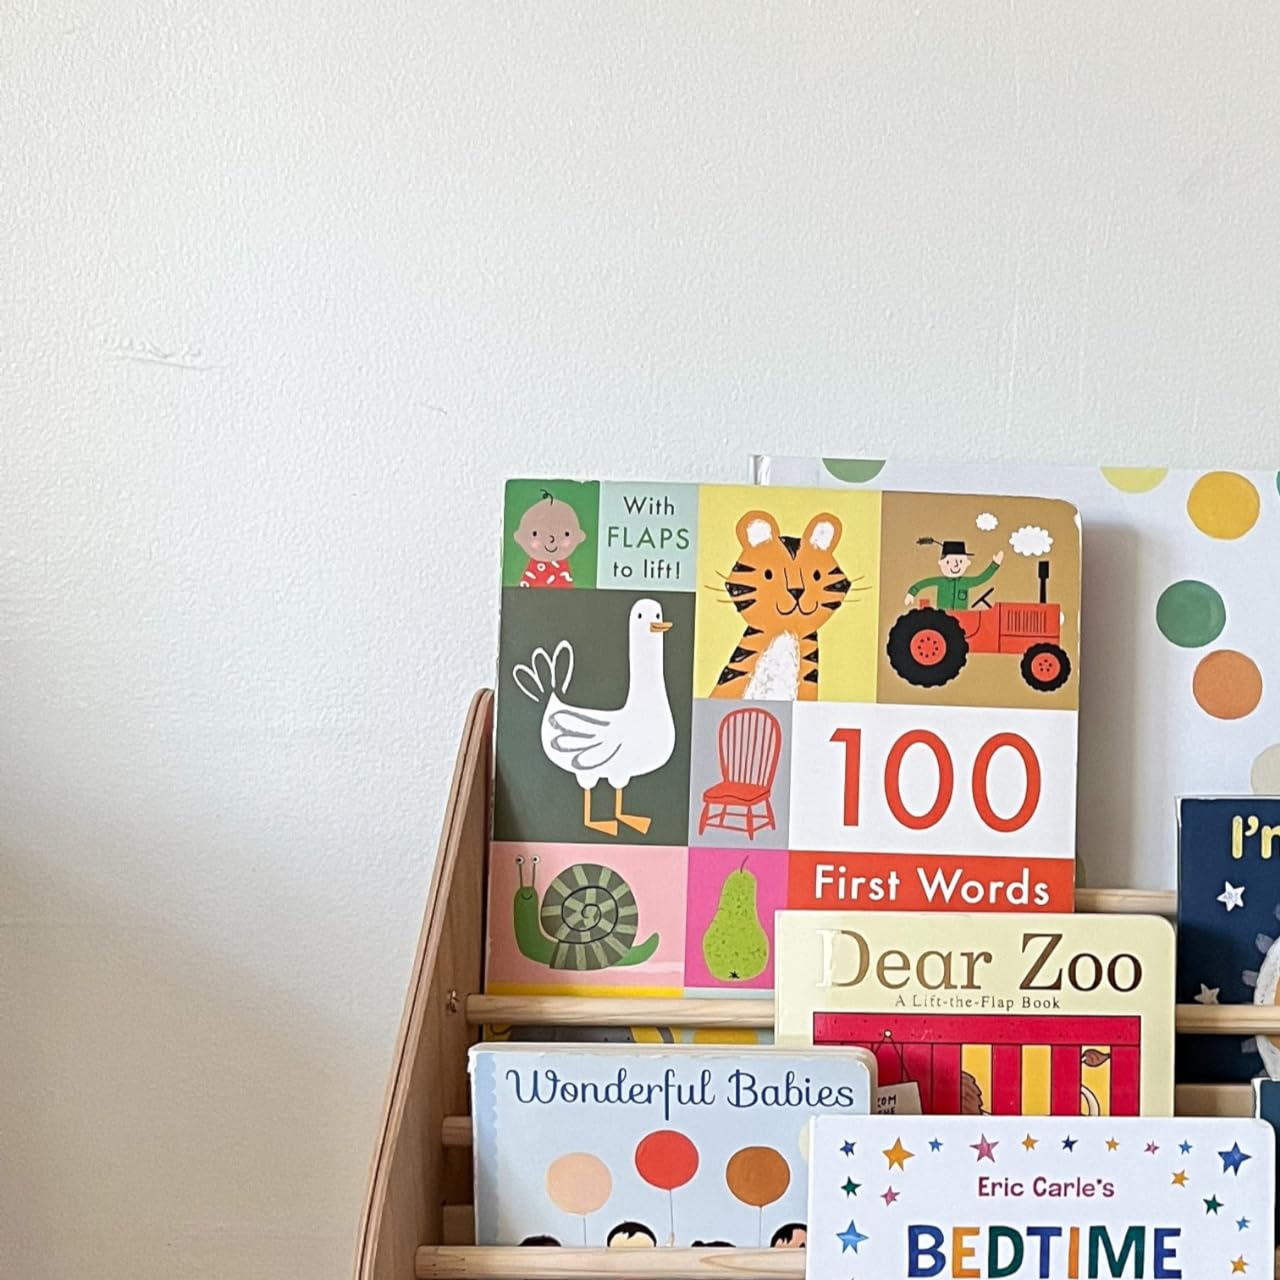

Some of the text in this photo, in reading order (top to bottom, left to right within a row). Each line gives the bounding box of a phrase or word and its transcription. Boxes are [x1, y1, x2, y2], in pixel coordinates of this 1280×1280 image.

[623, 495, 675, 516] With
[607, 526, 690, 550] FLAPS
[613, 559, 680, 580] to lift!
[828, 727, 1042, 834] 100
[815, 864, 1050, 907] First Words
[814, 928, 1143, 993] Dear Zoo
[895, 994, 1061, 1012] A Lift-the-Flap Book
[505, 1067, 854, 1121] Wonderful Babies
[978, 1175, 1115, 1198] Eric Carle's
[907, 1224, 1183, 1280] BEDTIME
